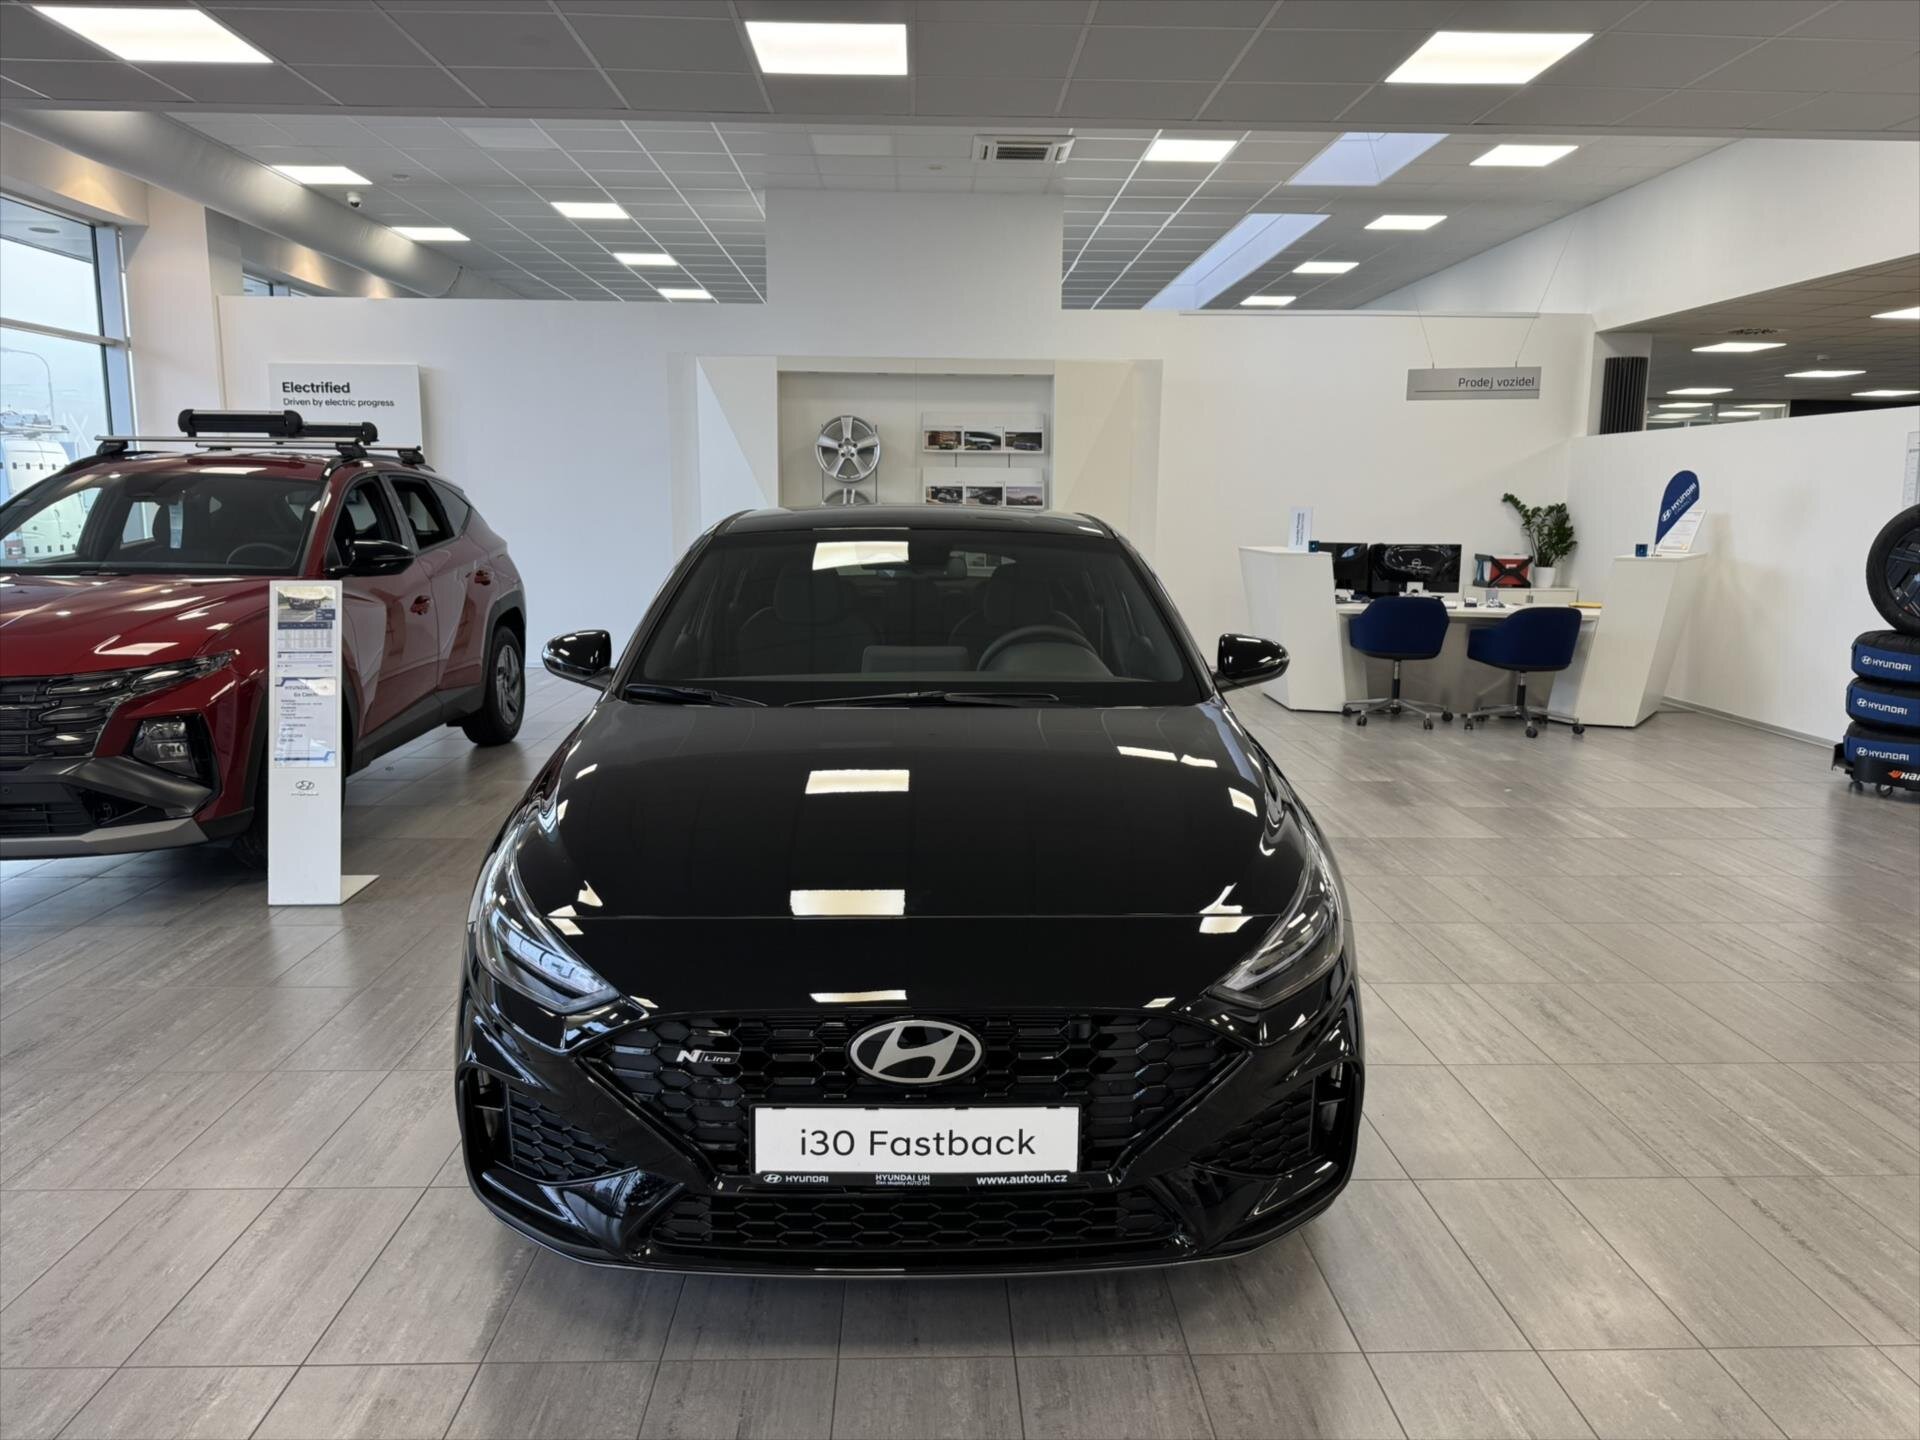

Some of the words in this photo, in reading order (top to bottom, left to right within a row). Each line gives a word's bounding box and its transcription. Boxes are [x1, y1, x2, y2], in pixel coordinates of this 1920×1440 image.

[282, 381, 351, 394] Electrified
[1458, 377, 1494, 389] Prodej
[1497, 376, 1535, 388] vozidel
[283, 397, 311, 407] Driven
[312, 397, 323, 408] by
[324, 398, 356, 408] electric
[357, 399, 395, 408] progress
[1671, 482, 1697, 511] HYUNDAI
[1872, 658, 1912, 672] HYUNDAI
[1868, 701, 1908, 715] HYUNDAI
[1868, 749, 1910, 761] HYUNDAI
[676, 1049, 702, 1063] N
[800, 1128, 855, 1156] i30
[869, 1128, 1036, 1156] Fastback
[785, 1175, 829, 1183] HYUNDAI
[976, 1173, 1068, 1185] www.autouh.cz
